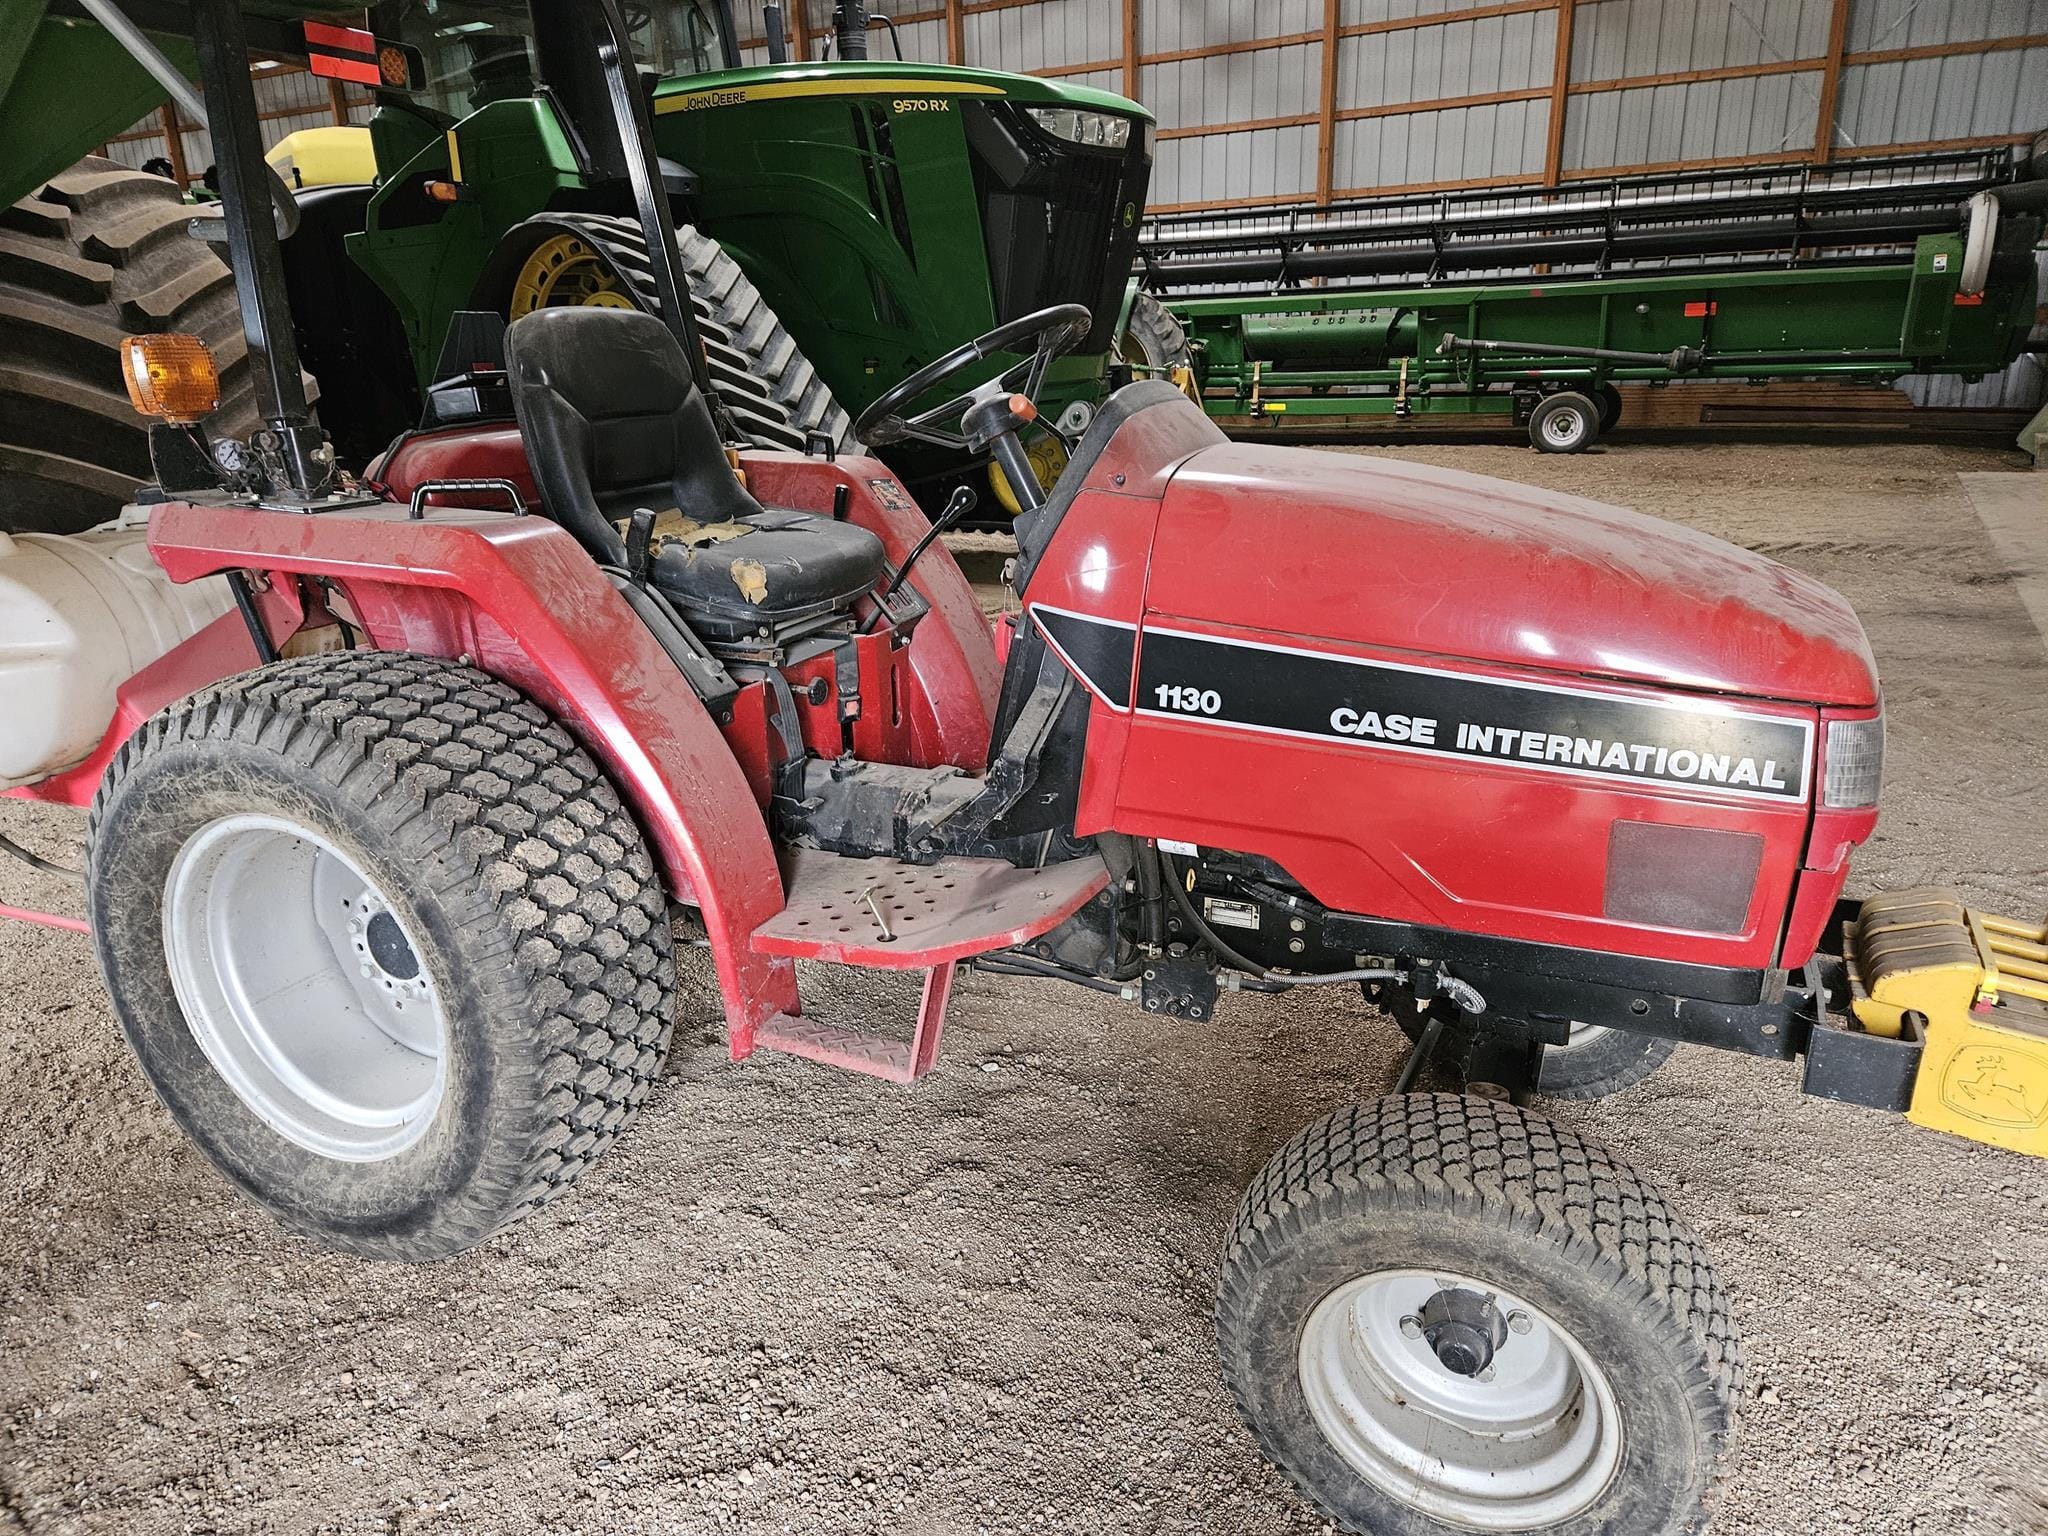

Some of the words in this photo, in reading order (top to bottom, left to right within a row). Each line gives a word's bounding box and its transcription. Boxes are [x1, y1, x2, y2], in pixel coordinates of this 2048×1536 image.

[684, 96, 711, 110] JOHN
[711, 91, 746, 107] DEERE
[893, 99, 928, 113] 9570
[930, 99, 949, 111] RX
[1154, 684, 1222, 715] 1130
[1329, 707, 1438, 744] CASE
[1455, 723, 1787, 789] INTERNATIONAL
